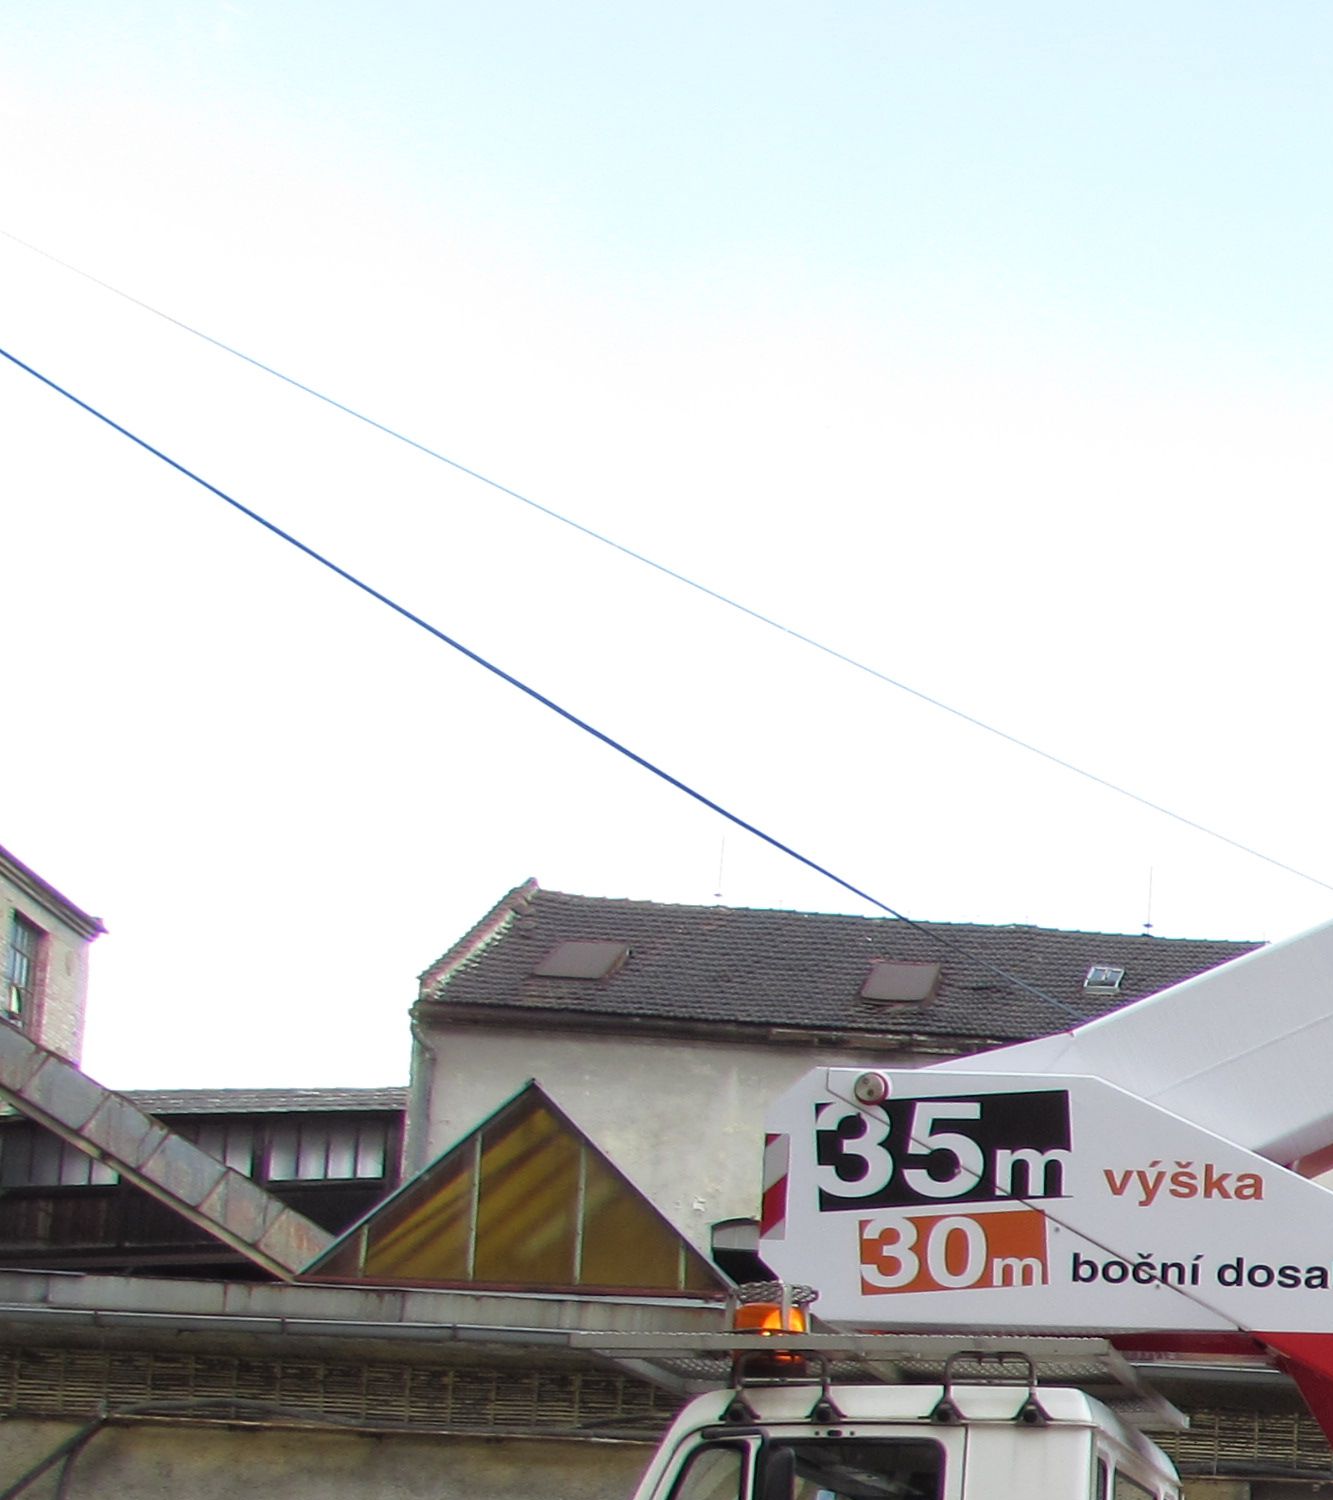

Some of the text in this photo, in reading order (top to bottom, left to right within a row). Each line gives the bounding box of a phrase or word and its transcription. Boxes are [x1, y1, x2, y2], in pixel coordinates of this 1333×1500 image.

[1103, 1161, 1265, 1208] výška
[861, 1215, 1046, 1289] 30m
[1070, 1251, 1204, 1287] boční
